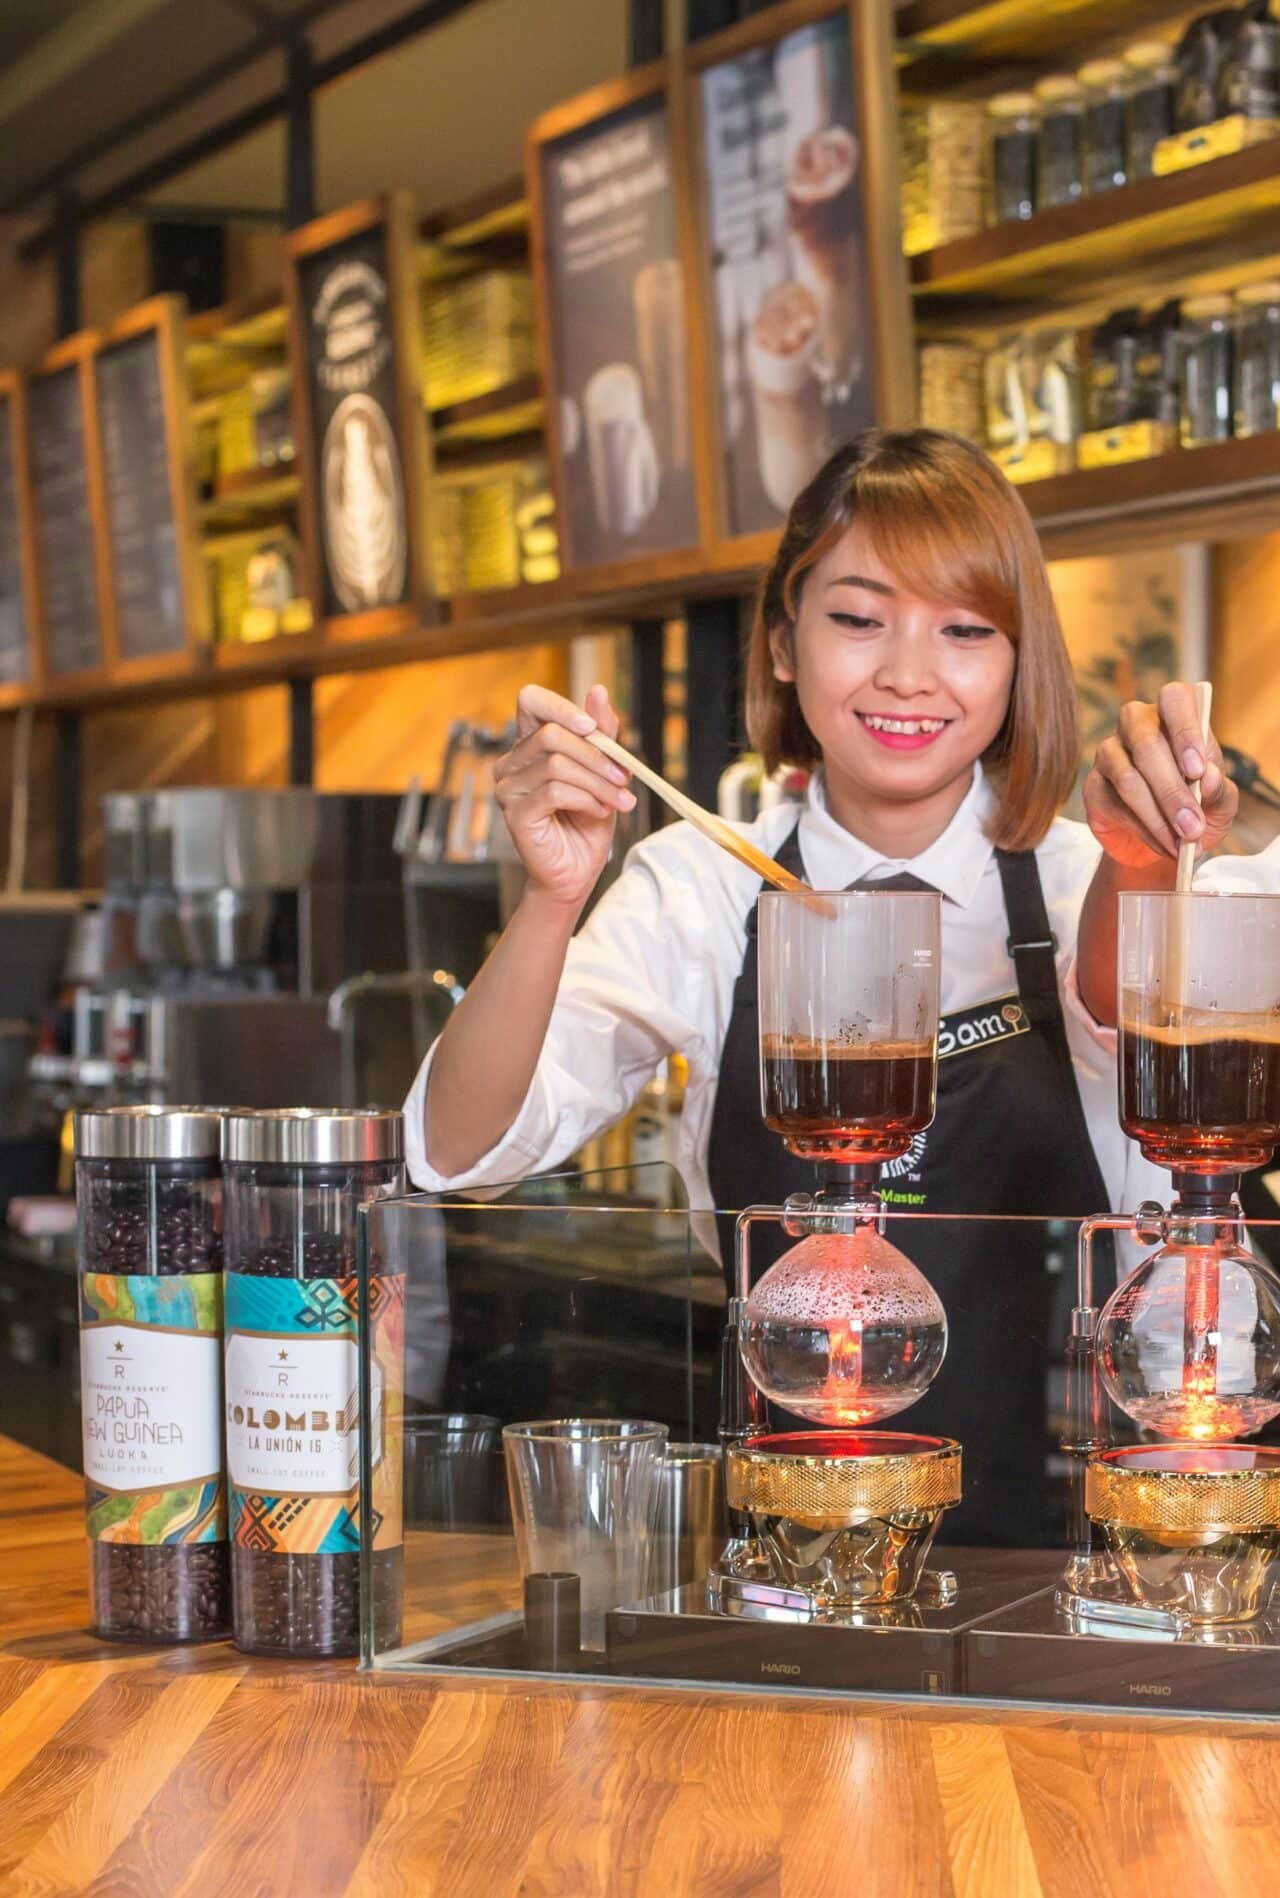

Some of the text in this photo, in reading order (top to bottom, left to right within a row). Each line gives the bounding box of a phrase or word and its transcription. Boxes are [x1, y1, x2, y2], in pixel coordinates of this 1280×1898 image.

[938, 1014, 1006, 1055] Sam
[881, 1189, 927, 1204] Master
[114, 1364, 125, 1379] R
[278, 1373, 289, 1386] R
[97, 1394, 149, 1419] PAPUA
[113, 1421, 183, 1445] GUINEA
[248, 1437, 260, 1450] LA
[266, 1437, 302, 1453] UNIÓN
[761, 1662, 800, 1675] HARIO
[1129, 1683, 1172, 1696] HARIO
